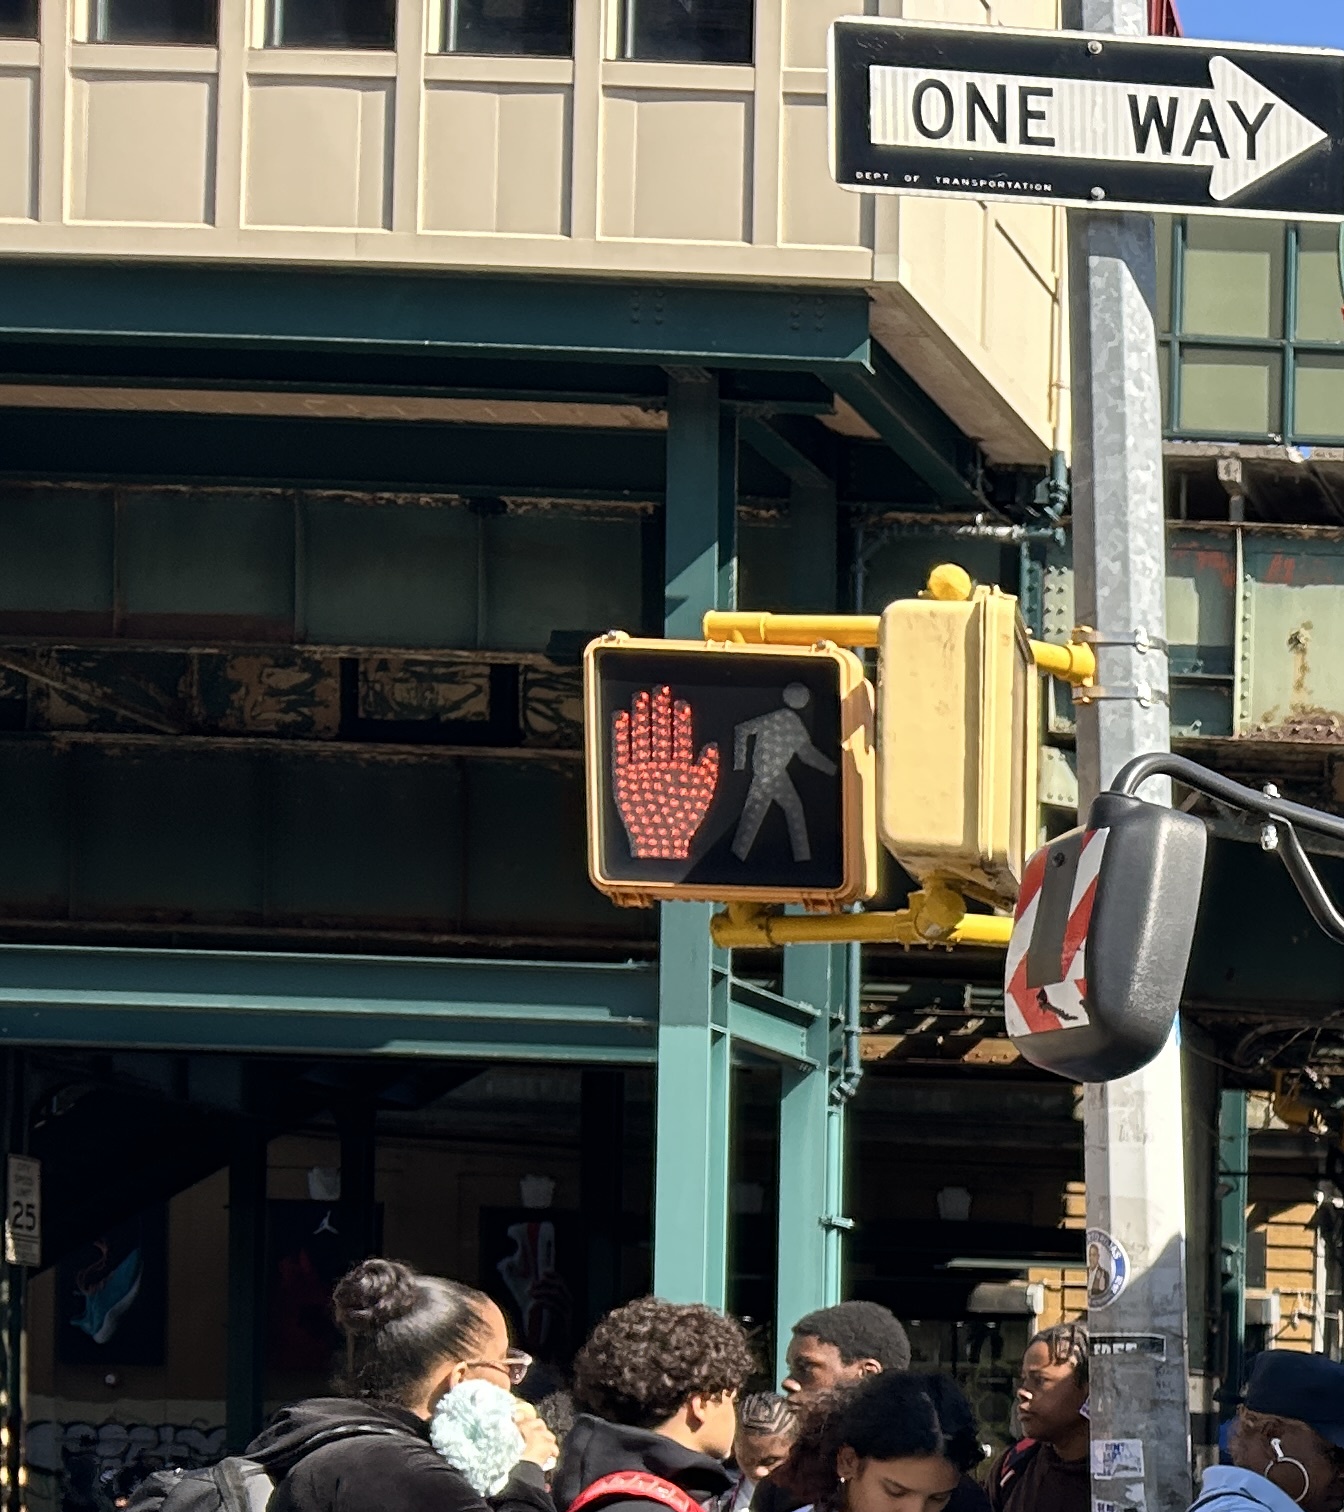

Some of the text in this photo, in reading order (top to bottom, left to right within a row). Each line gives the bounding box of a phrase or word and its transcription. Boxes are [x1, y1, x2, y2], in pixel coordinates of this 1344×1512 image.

[912, 78, 1275, 161] ONE WAY
[855, 171, 1053, 192] DEPT OF TRANSPORTATION
[12, 1200, 36, 1231] 25
